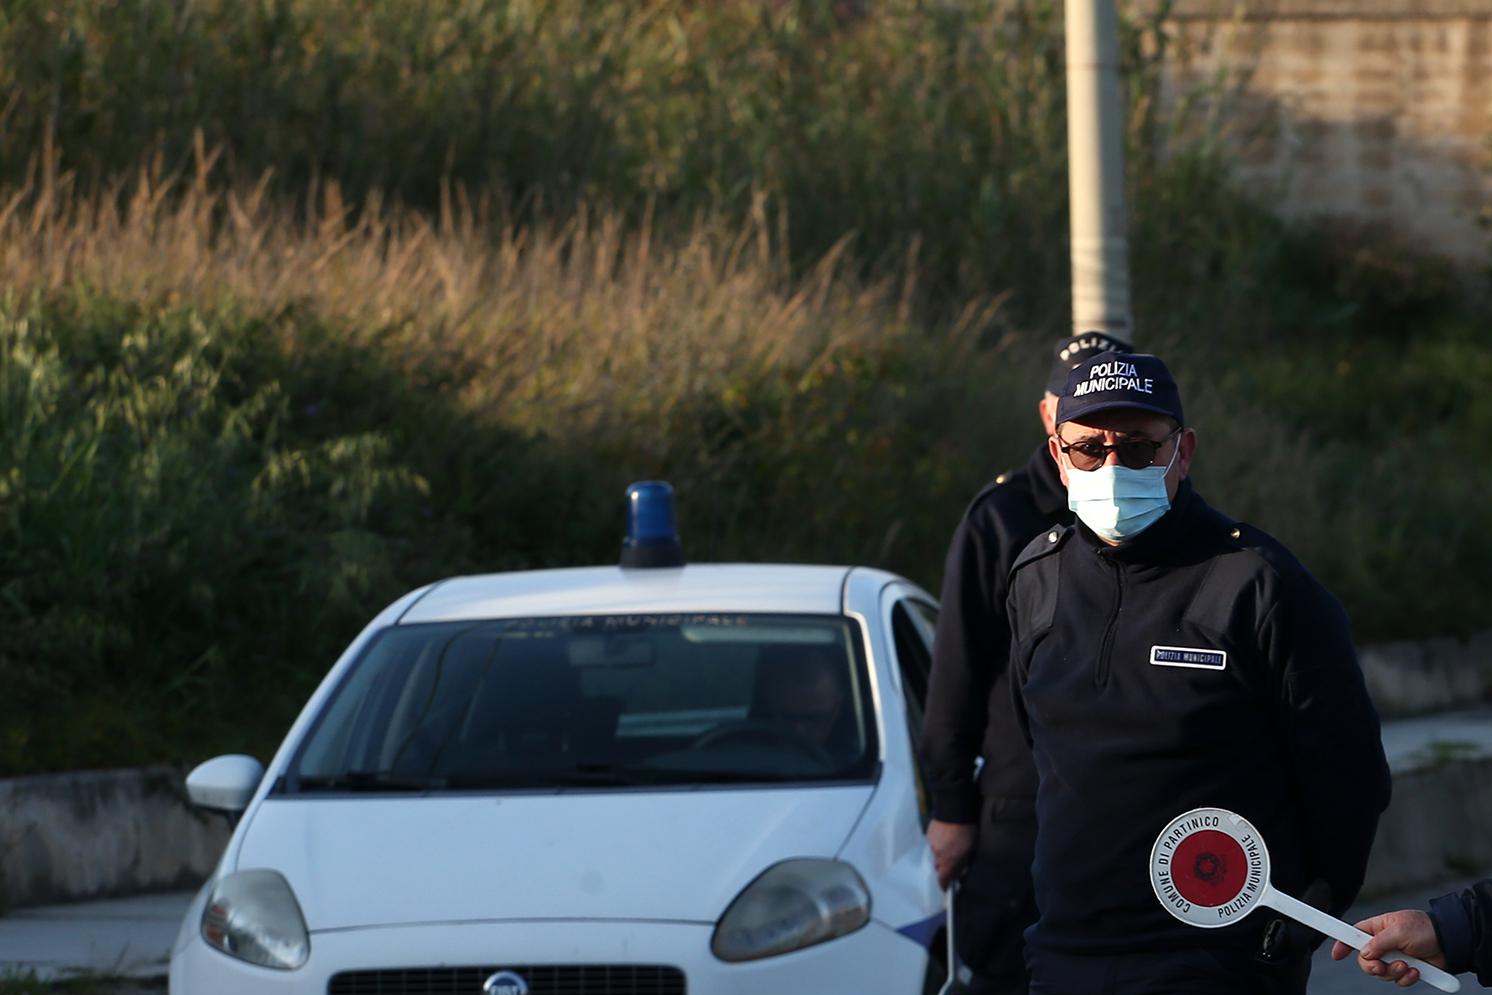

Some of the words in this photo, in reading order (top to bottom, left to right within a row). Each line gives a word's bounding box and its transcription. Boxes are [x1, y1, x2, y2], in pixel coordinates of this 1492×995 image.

[1089, 361, 1138, 380] POLIZIA
[1073, 377, 1154, 397] MUNICIPALE
[1163, 816, 1220, 850] PARTINICO
[1158, 853, 1170, 865] DI
[1217, 892, 1253, 918] POLIZIA
[1241, 834, 1262, 893] MUNICIPALE
[1158, 870, 1191, 914] COMUNE
